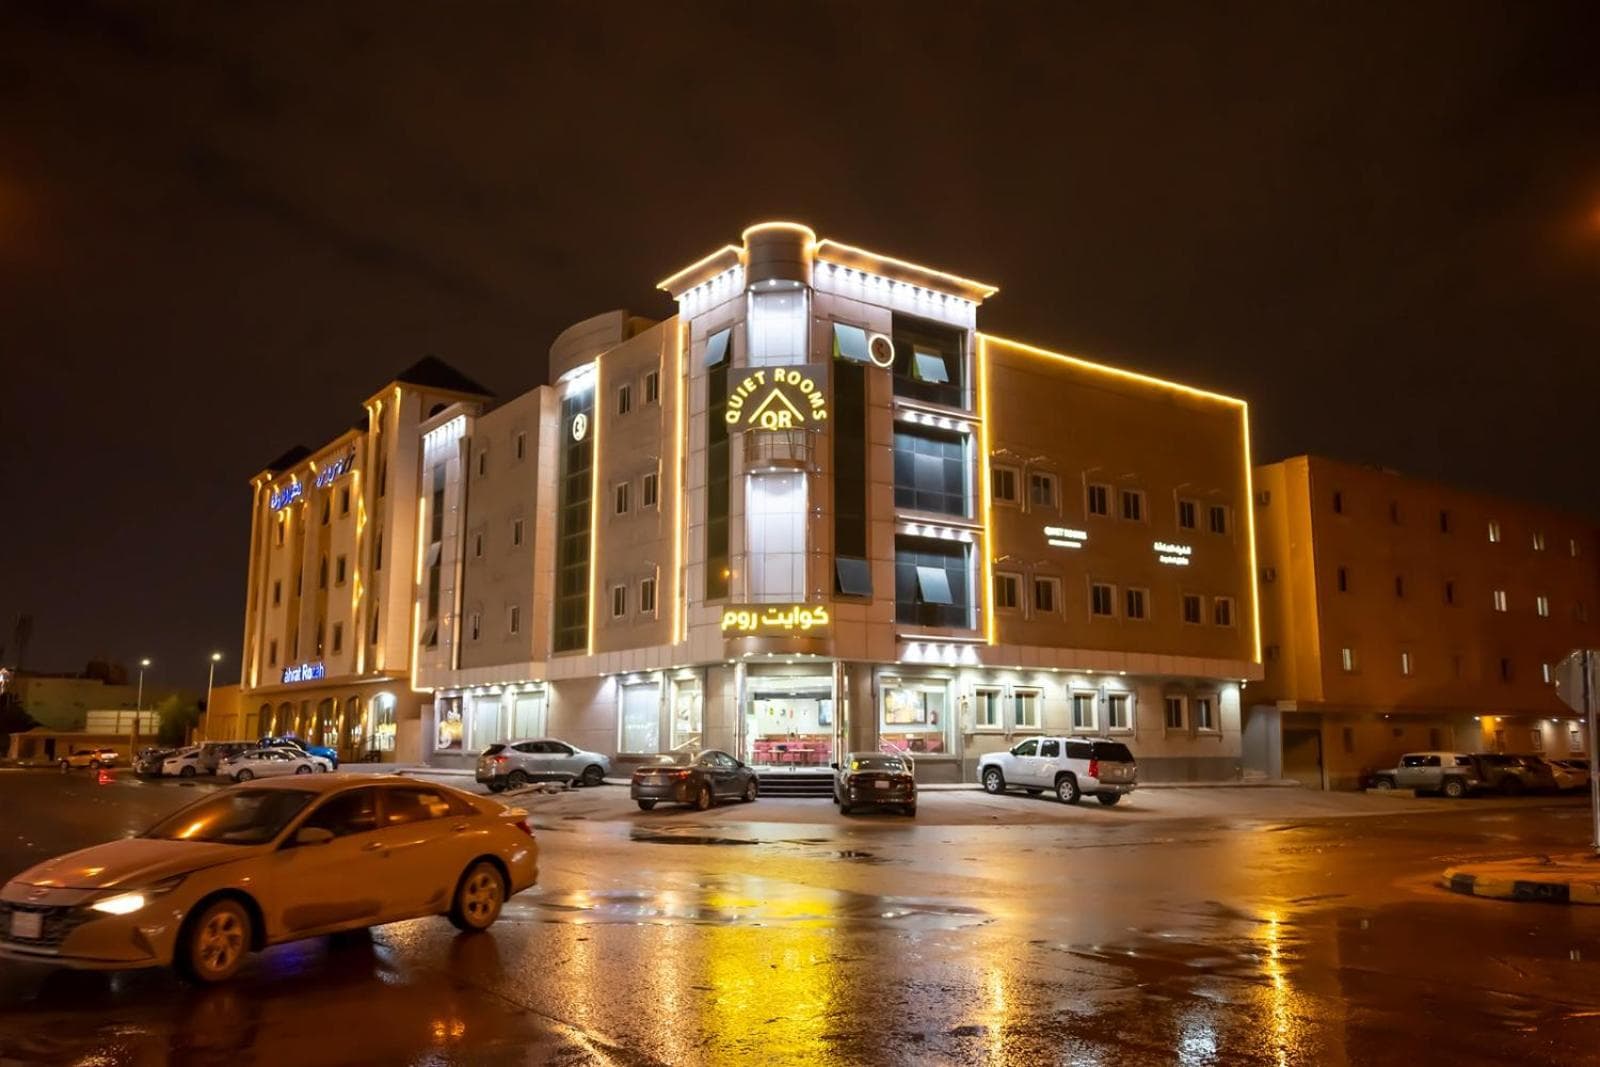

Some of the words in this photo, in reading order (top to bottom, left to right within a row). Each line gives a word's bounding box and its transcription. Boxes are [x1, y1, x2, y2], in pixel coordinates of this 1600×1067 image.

[725, 370, 765, 424] QUIET
[774, 368, 827, 420] ROOMS
[760, 410, 792, 431] QR
[721, 610, 758, 631] روم
[761, 605, 829, 629] كوايت
